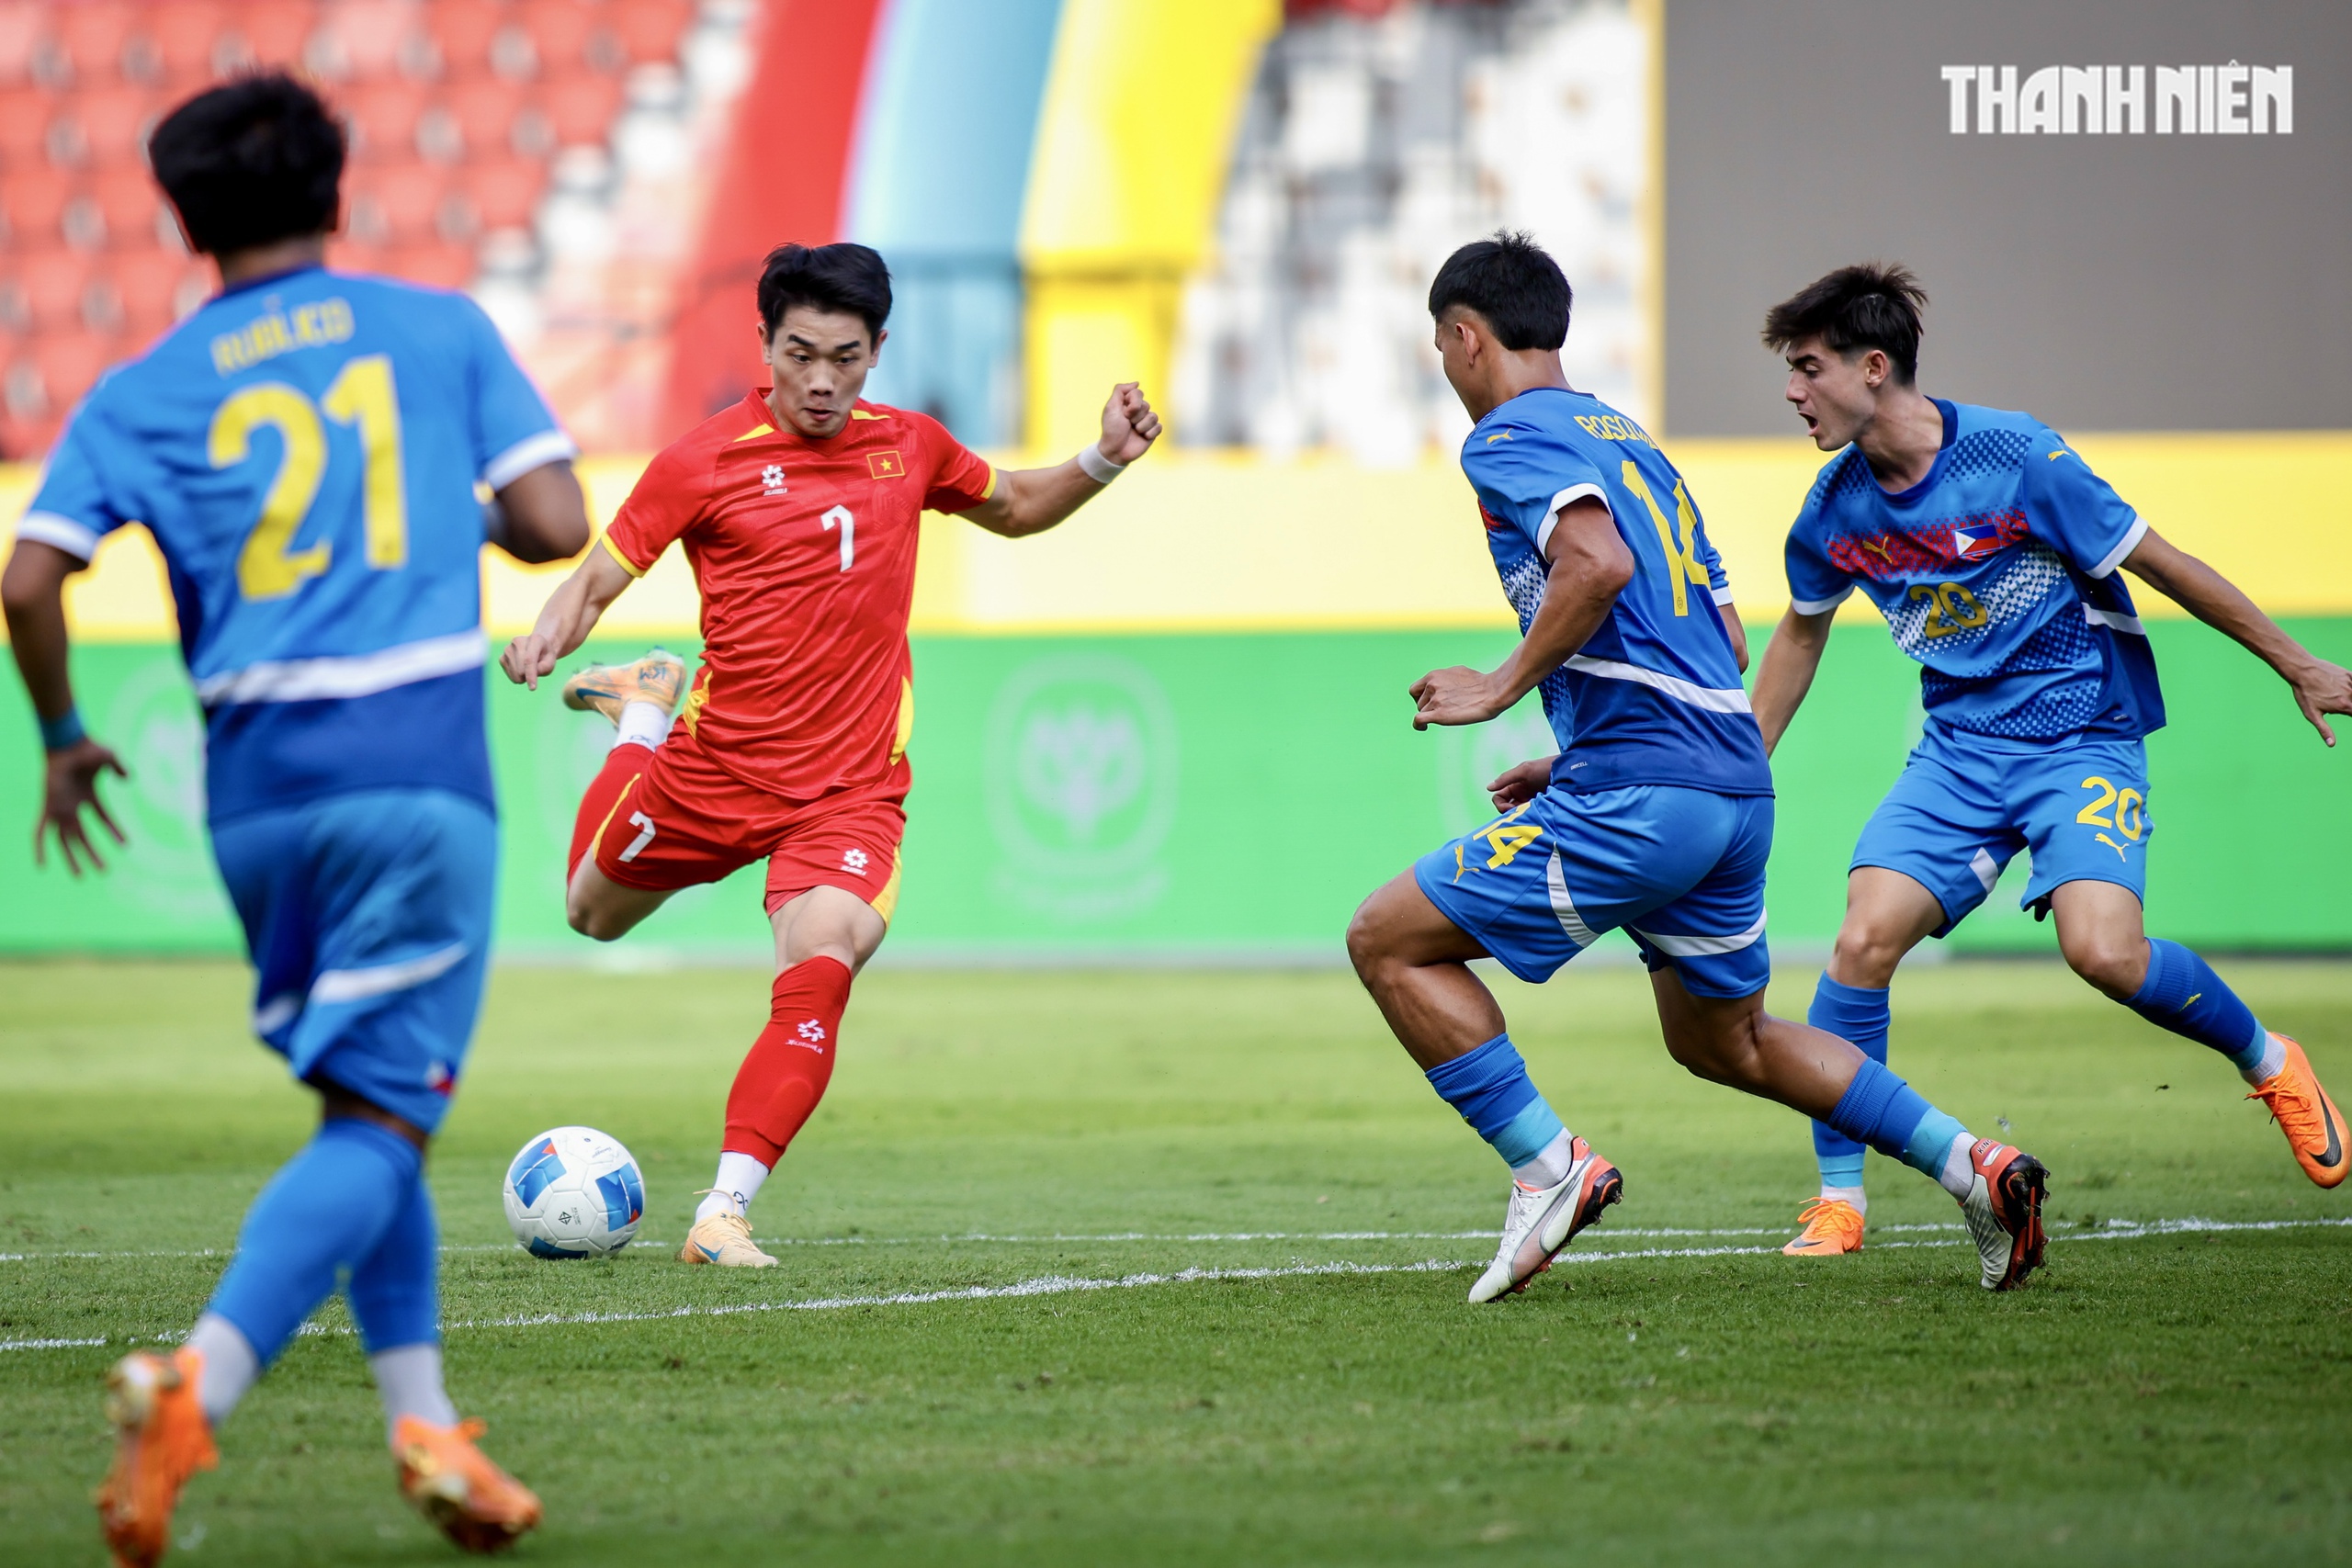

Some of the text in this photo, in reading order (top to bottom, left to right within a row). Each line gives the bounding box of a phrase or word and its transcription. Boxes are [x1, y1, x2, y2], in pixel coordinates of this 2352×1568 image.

[208, 355, 407, 601] 21
[820, 503, 854, 573] 7
[1908, 581, 1988, 640] 20
[617, 810, 657, 863] 7
[1472, 801, 1544, 870] 14
[2075, 775, 2143, 841] 20
